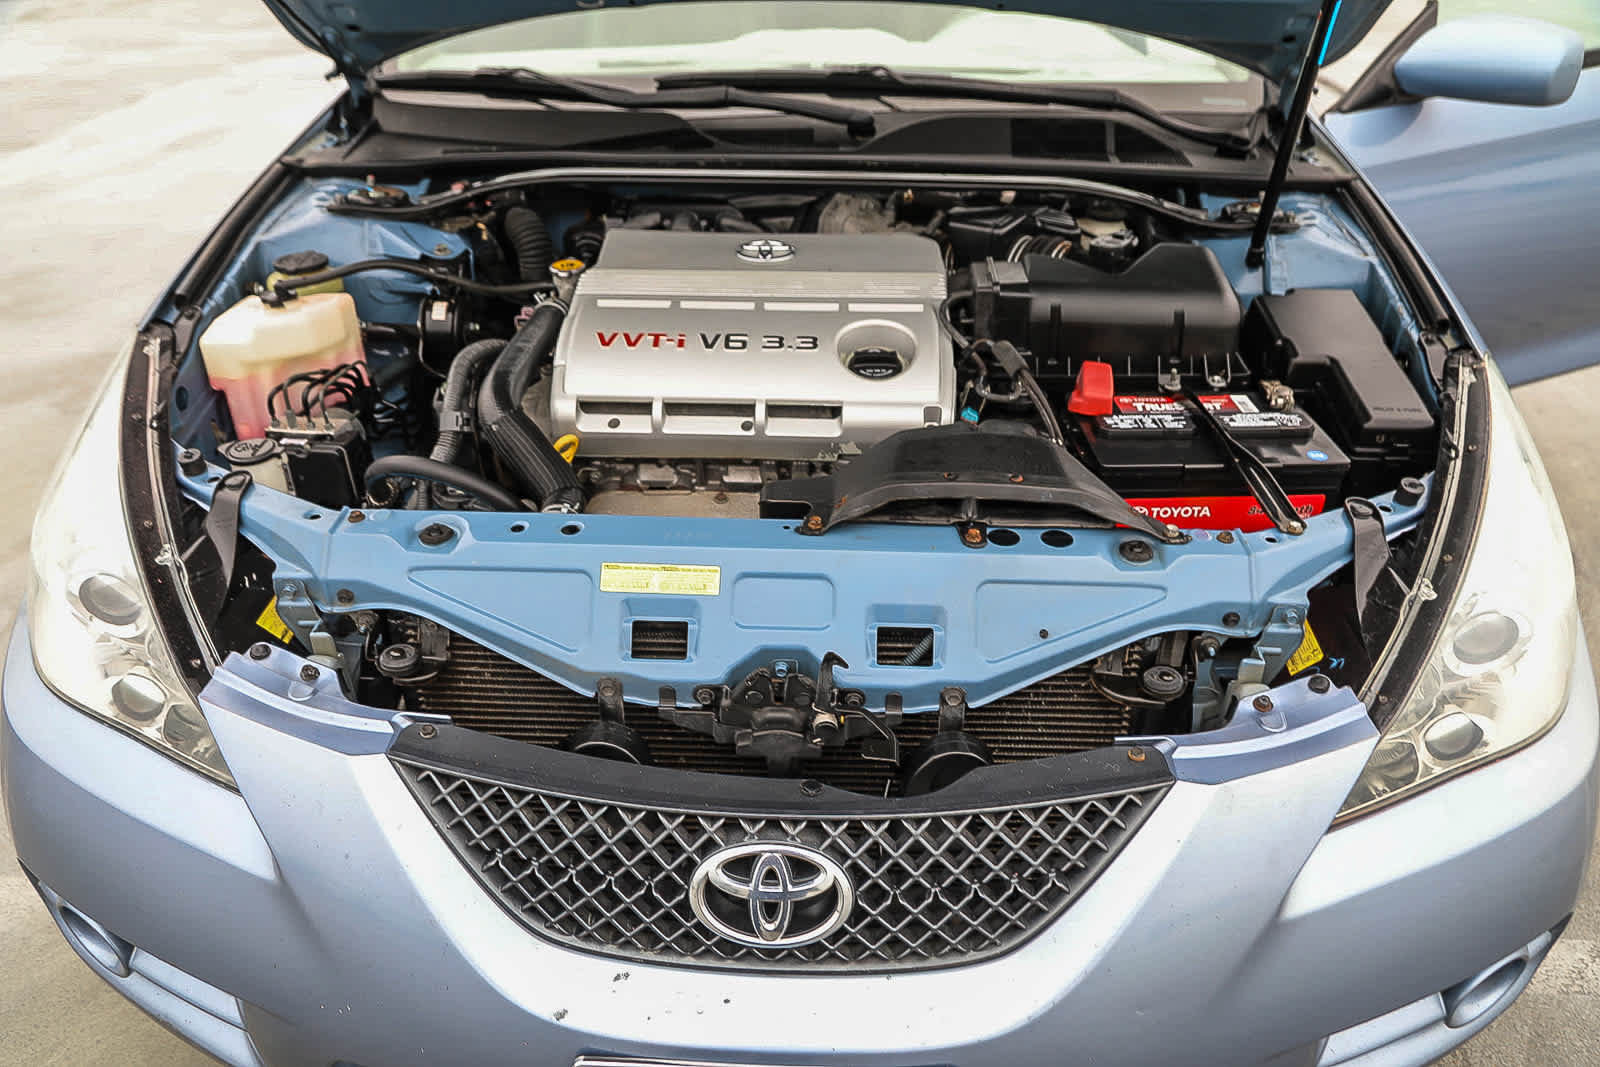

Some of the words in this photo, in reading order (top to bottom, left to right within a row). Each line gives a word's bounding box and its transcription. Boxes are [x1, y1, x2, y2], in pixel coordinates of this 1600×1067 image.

[597, 332, 686, 348] VVT-i
[700, 333, 748, 350] V6
[761, 335, 818, 350] 3.3
[1151, 506, 1211, 518] TOYOTA
